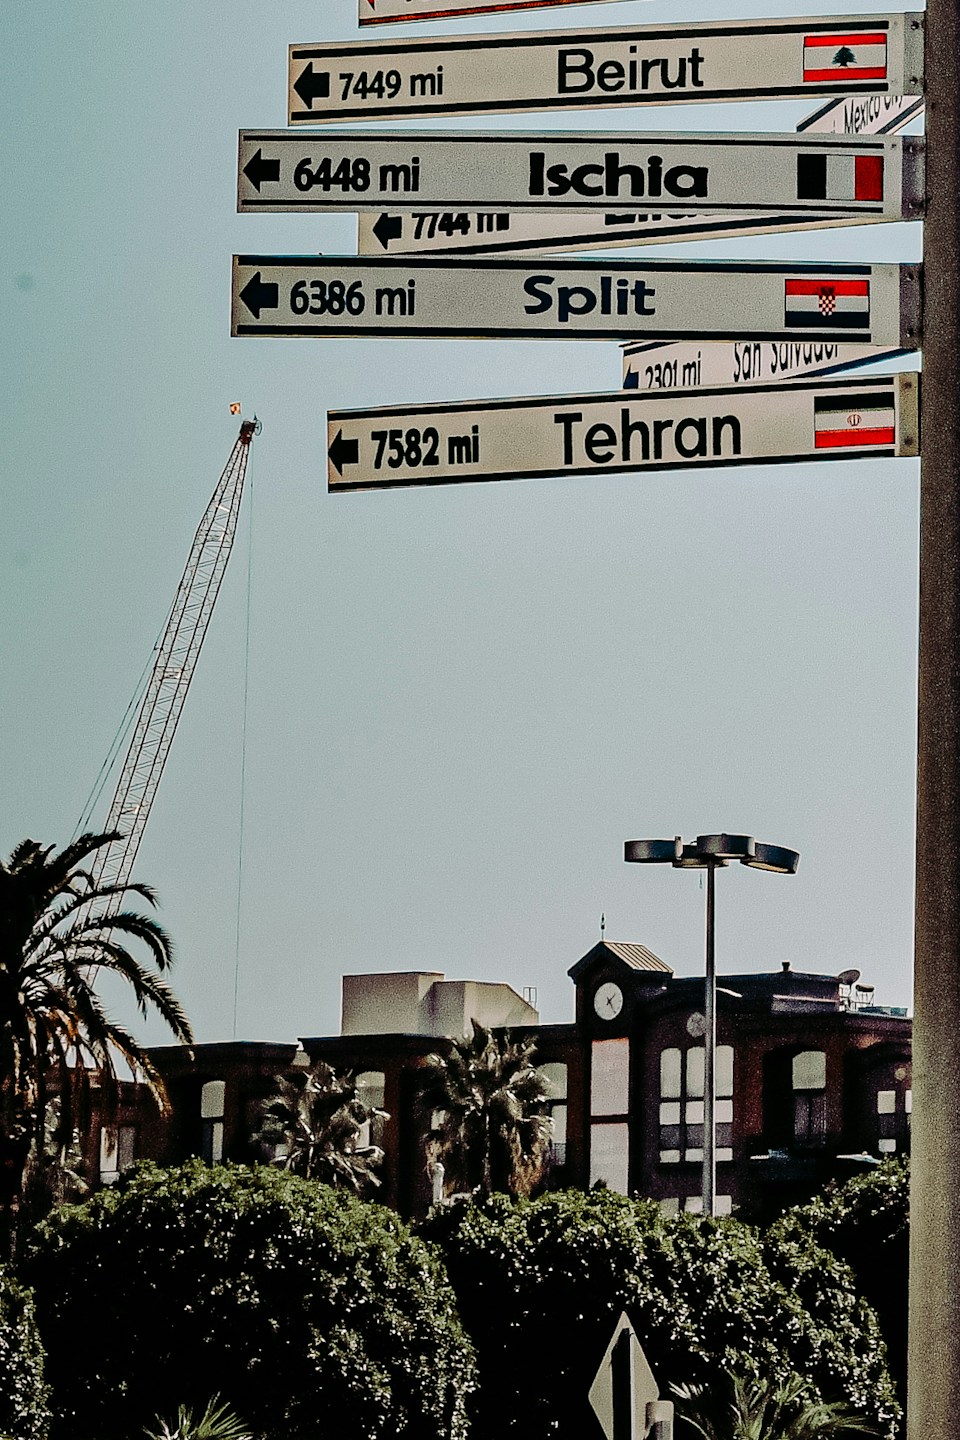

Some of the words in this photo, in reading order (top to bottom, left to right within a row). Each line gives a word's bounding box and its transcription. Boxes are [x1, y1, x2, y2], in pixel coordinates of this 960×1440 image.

[338, 73, 402, 102] 7449
[410, 65, 443, 97] mi
[557, 46, 704, 95] Beirut
[293, 158, 370, 192] 6448
[379, 157, 420, 193] mi
[528, 152, 709, 199] Ischia
[290, 281, 364, 316] 6386
[375, 279, 415, 316] mi
[523, 274, 656, 323] Split
[682, 350, 701, 386] mi
[733, 342, 761, 383] San
[371, 428, 439, 468] 7582
[448, 425, 479, 465] mi
[553, 409, 742, 465] Tehran
